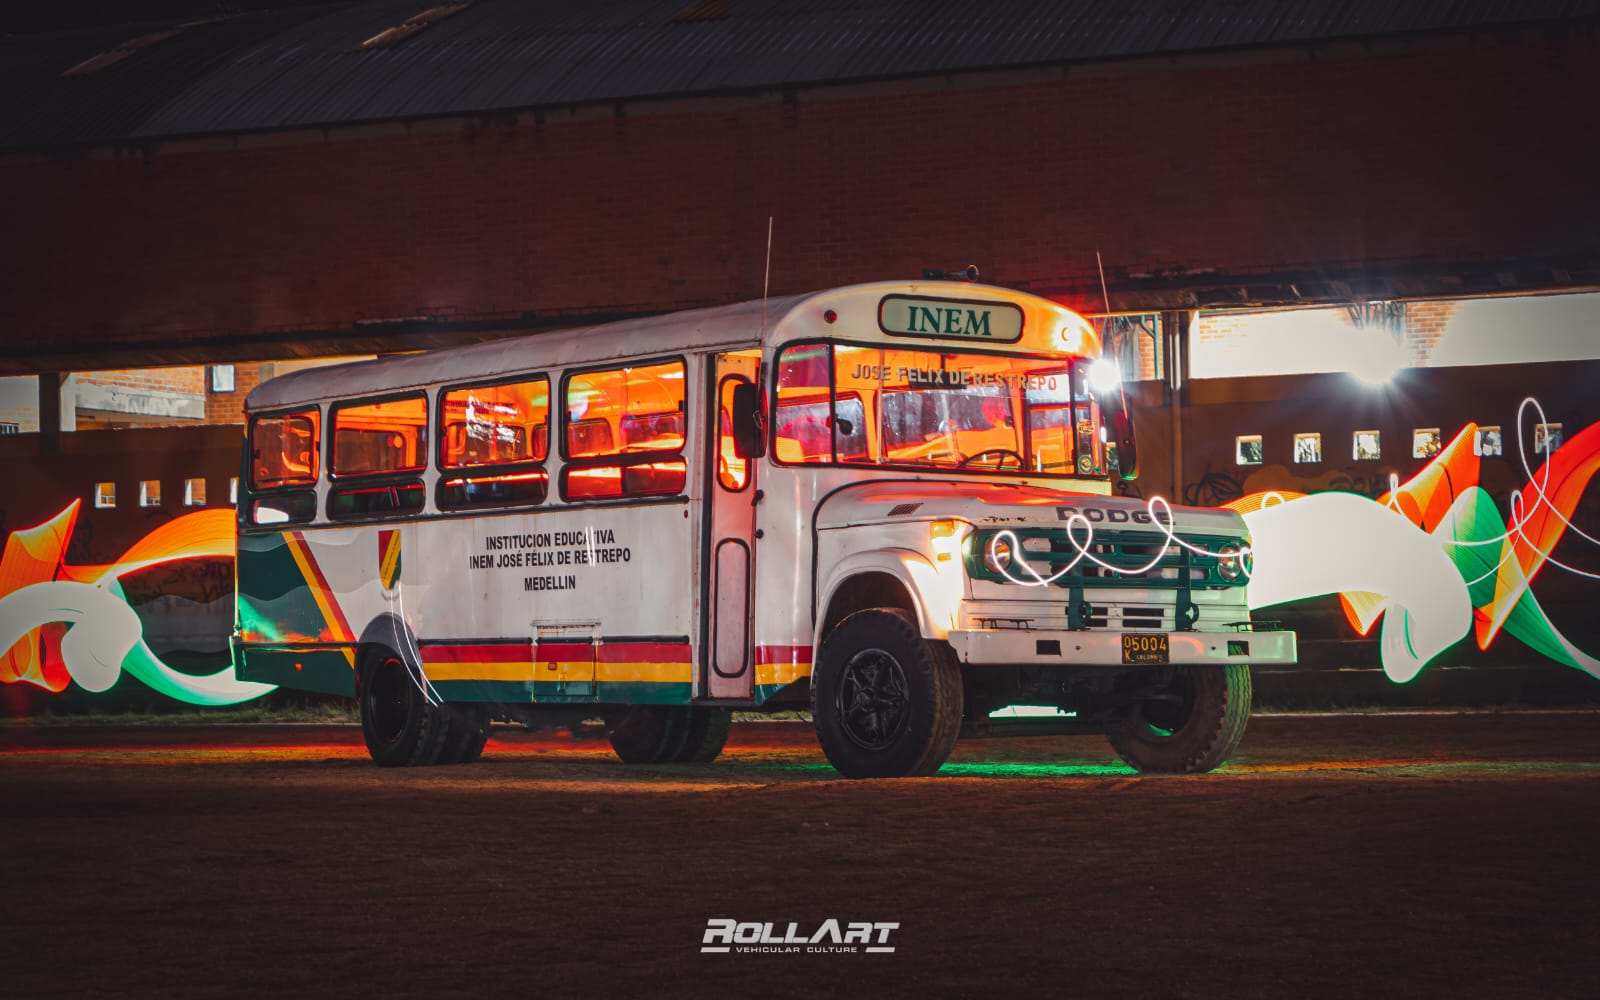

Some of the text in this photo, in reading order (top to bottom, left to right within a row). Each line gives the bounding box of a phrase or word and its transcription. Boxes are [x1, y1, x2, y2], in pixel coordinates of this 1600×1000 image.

[907, 305, 992, 336] INEM
[851, 364, 1057, 391] JOSE FELIX DE RESTREPO
[1056, 506, 1176, 526] DODGE
[486, 529, 615, 550] INSTITUCION EDUCAIVA
[469, 553, 494, 569] INEM
[497, 551, 523, 568] JOSÉ
[525, 550, 554, 567] FÉLIX
[557, 549, 571, 565] DE
[524, 575, 576, 592] MEDELLIN
